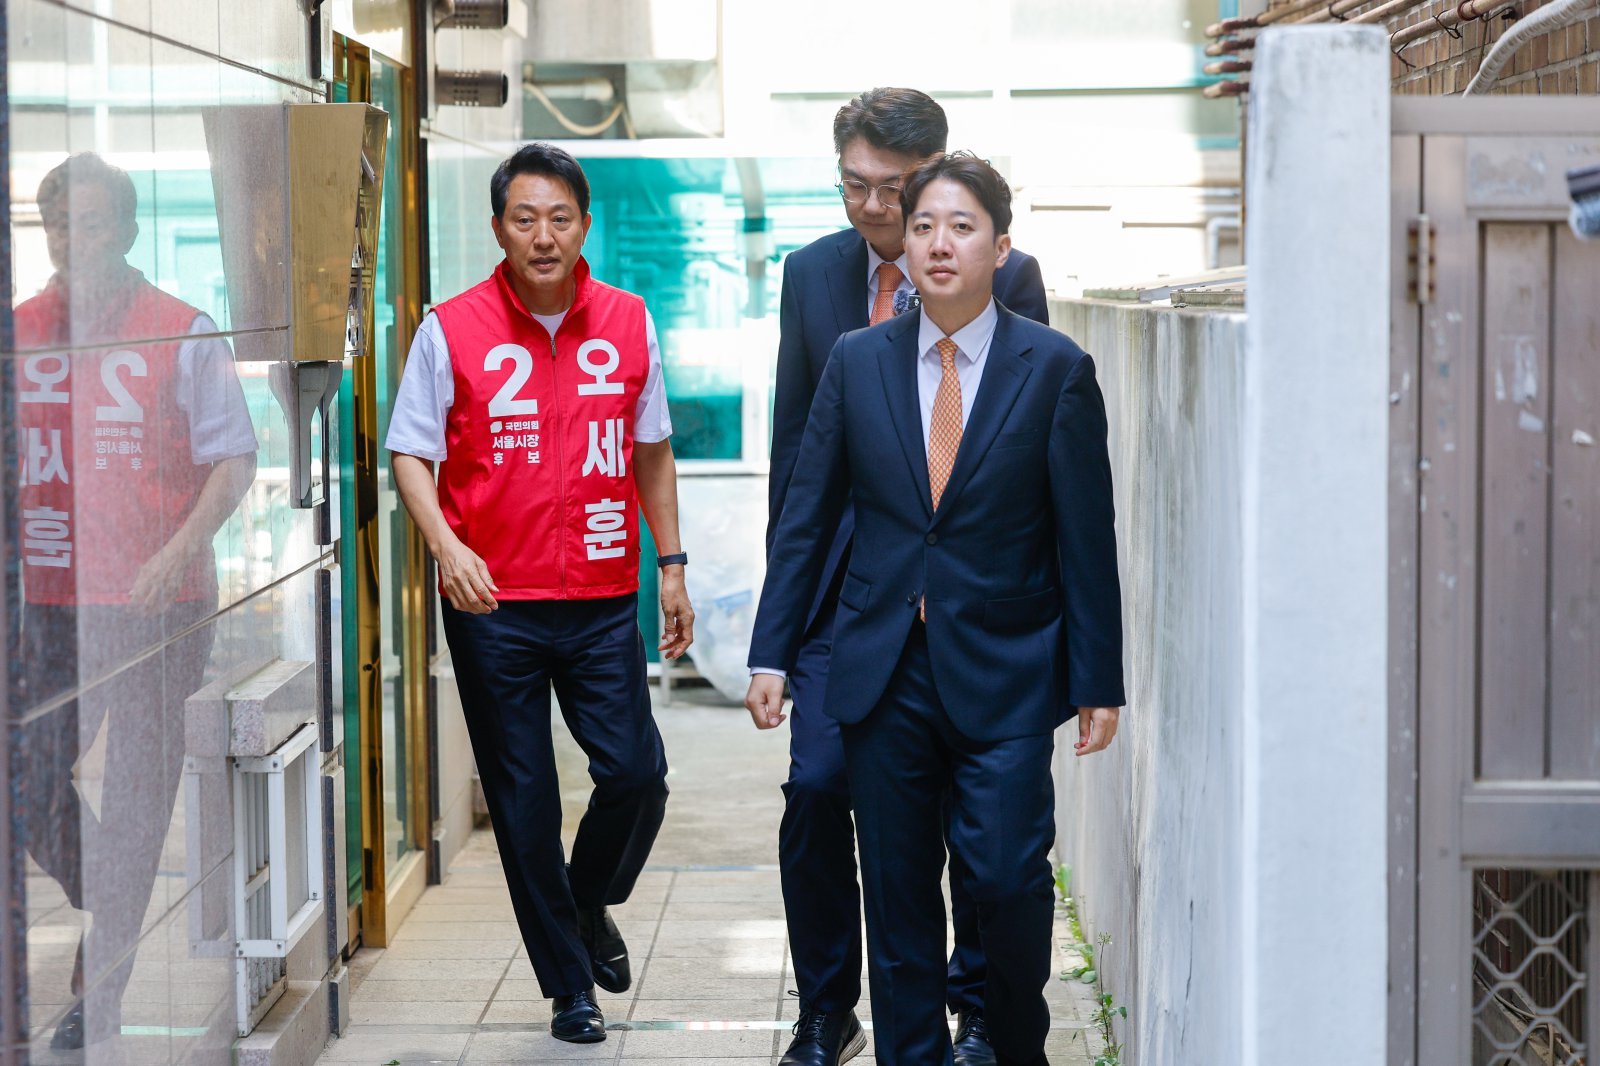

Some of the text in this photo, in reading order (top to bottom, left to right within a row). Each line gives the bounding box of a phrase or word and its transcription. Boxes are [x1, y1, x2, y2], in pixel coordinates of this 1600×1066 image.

[483, 343, 539, 418] 2
[492, 434, 540, 449] 서울시장
[505, 420, 539, 431] 국민의힘
[576, 338, 627, 561] 오세훈
